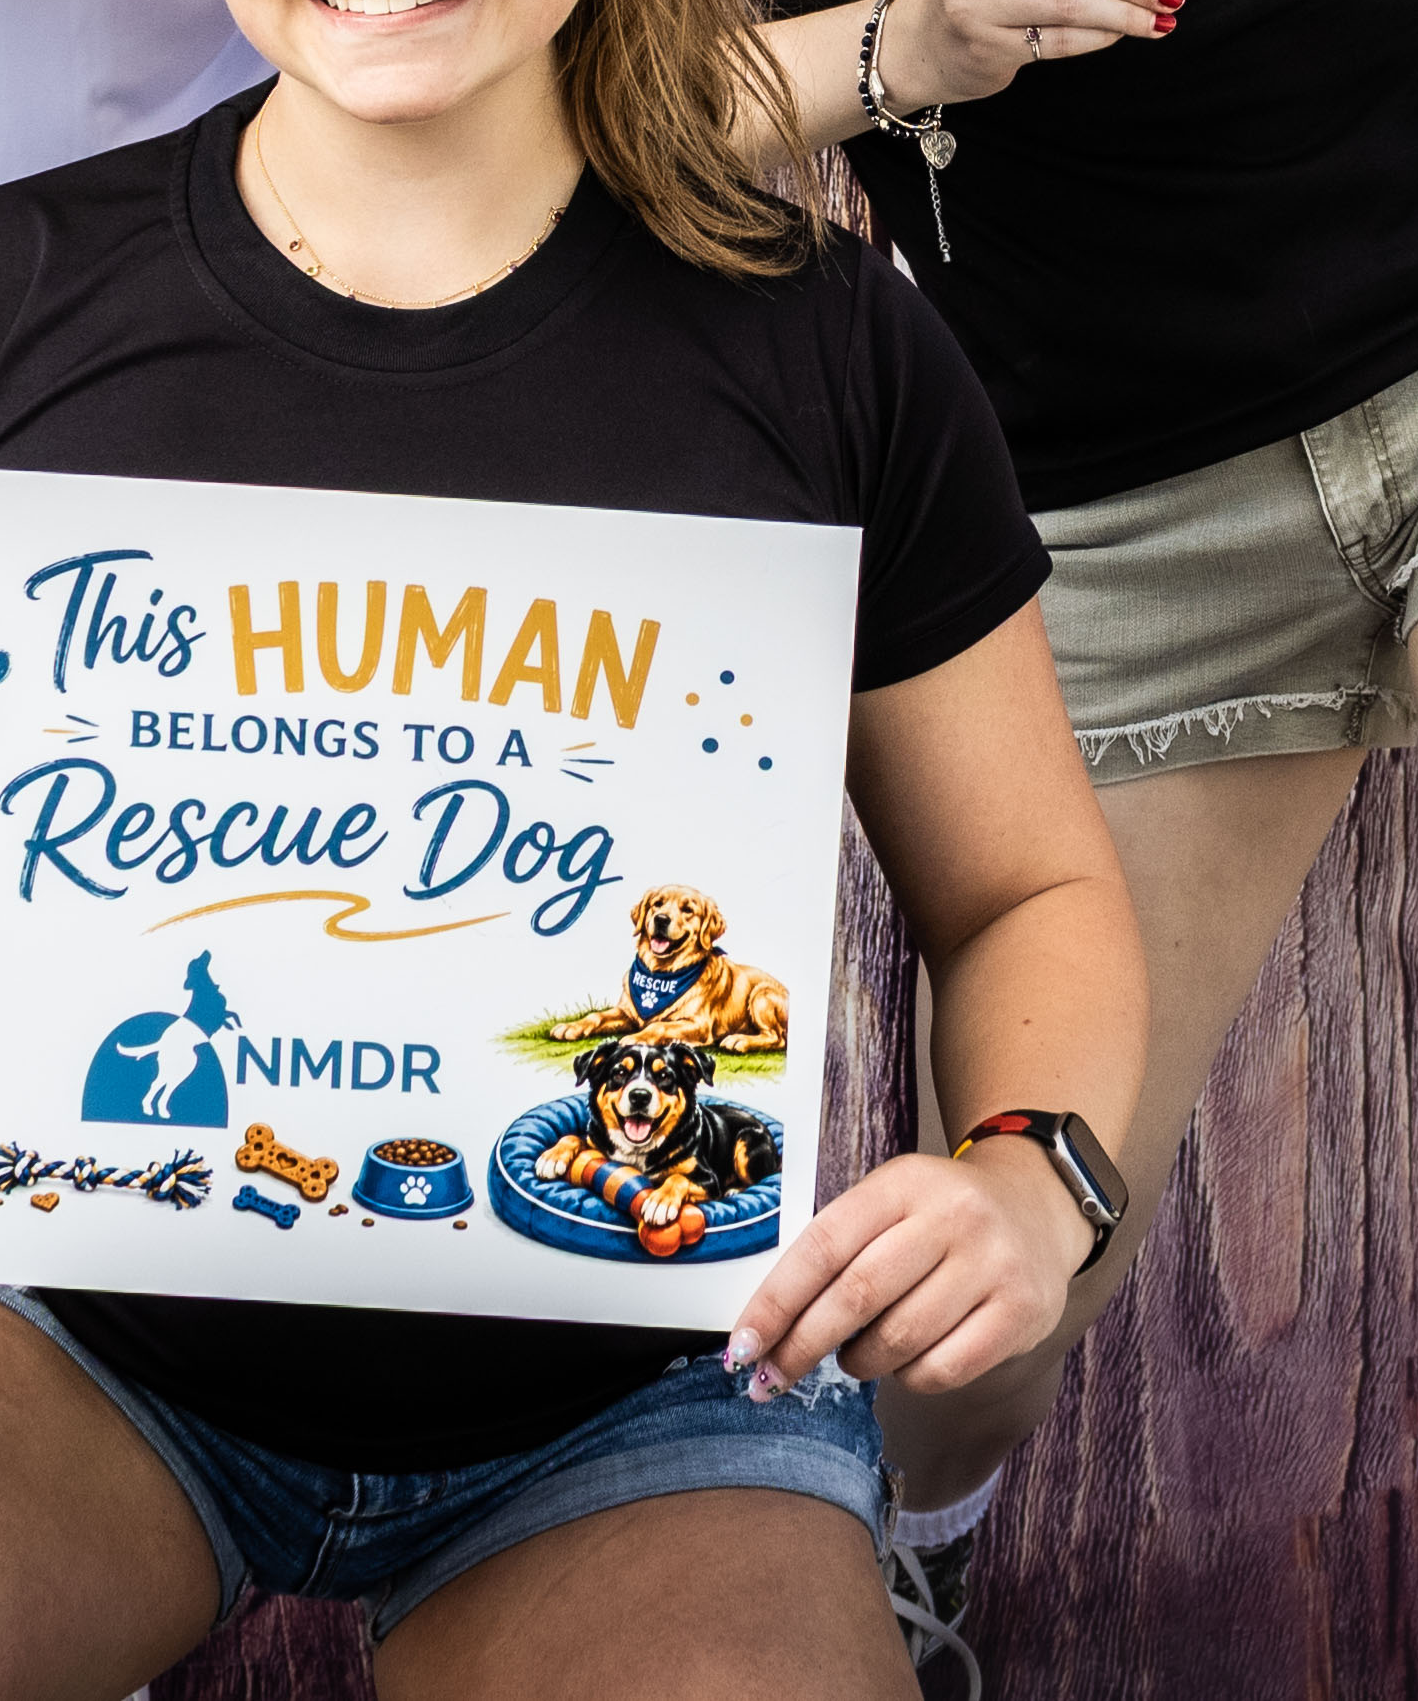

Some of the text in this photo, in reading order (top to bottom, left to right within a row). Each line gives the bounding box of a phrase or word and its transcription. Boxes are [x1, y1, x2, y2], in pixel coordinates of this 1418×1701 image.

[24, 550, 661, 729] This HUMAN
[130, 710, 532, 767] BELONGS TO A
[0, 758, 623, 936] Rescue Dog
[633, 971, 678, 994] RESCUE
[236, 1036, 440, 1093] NMDR
